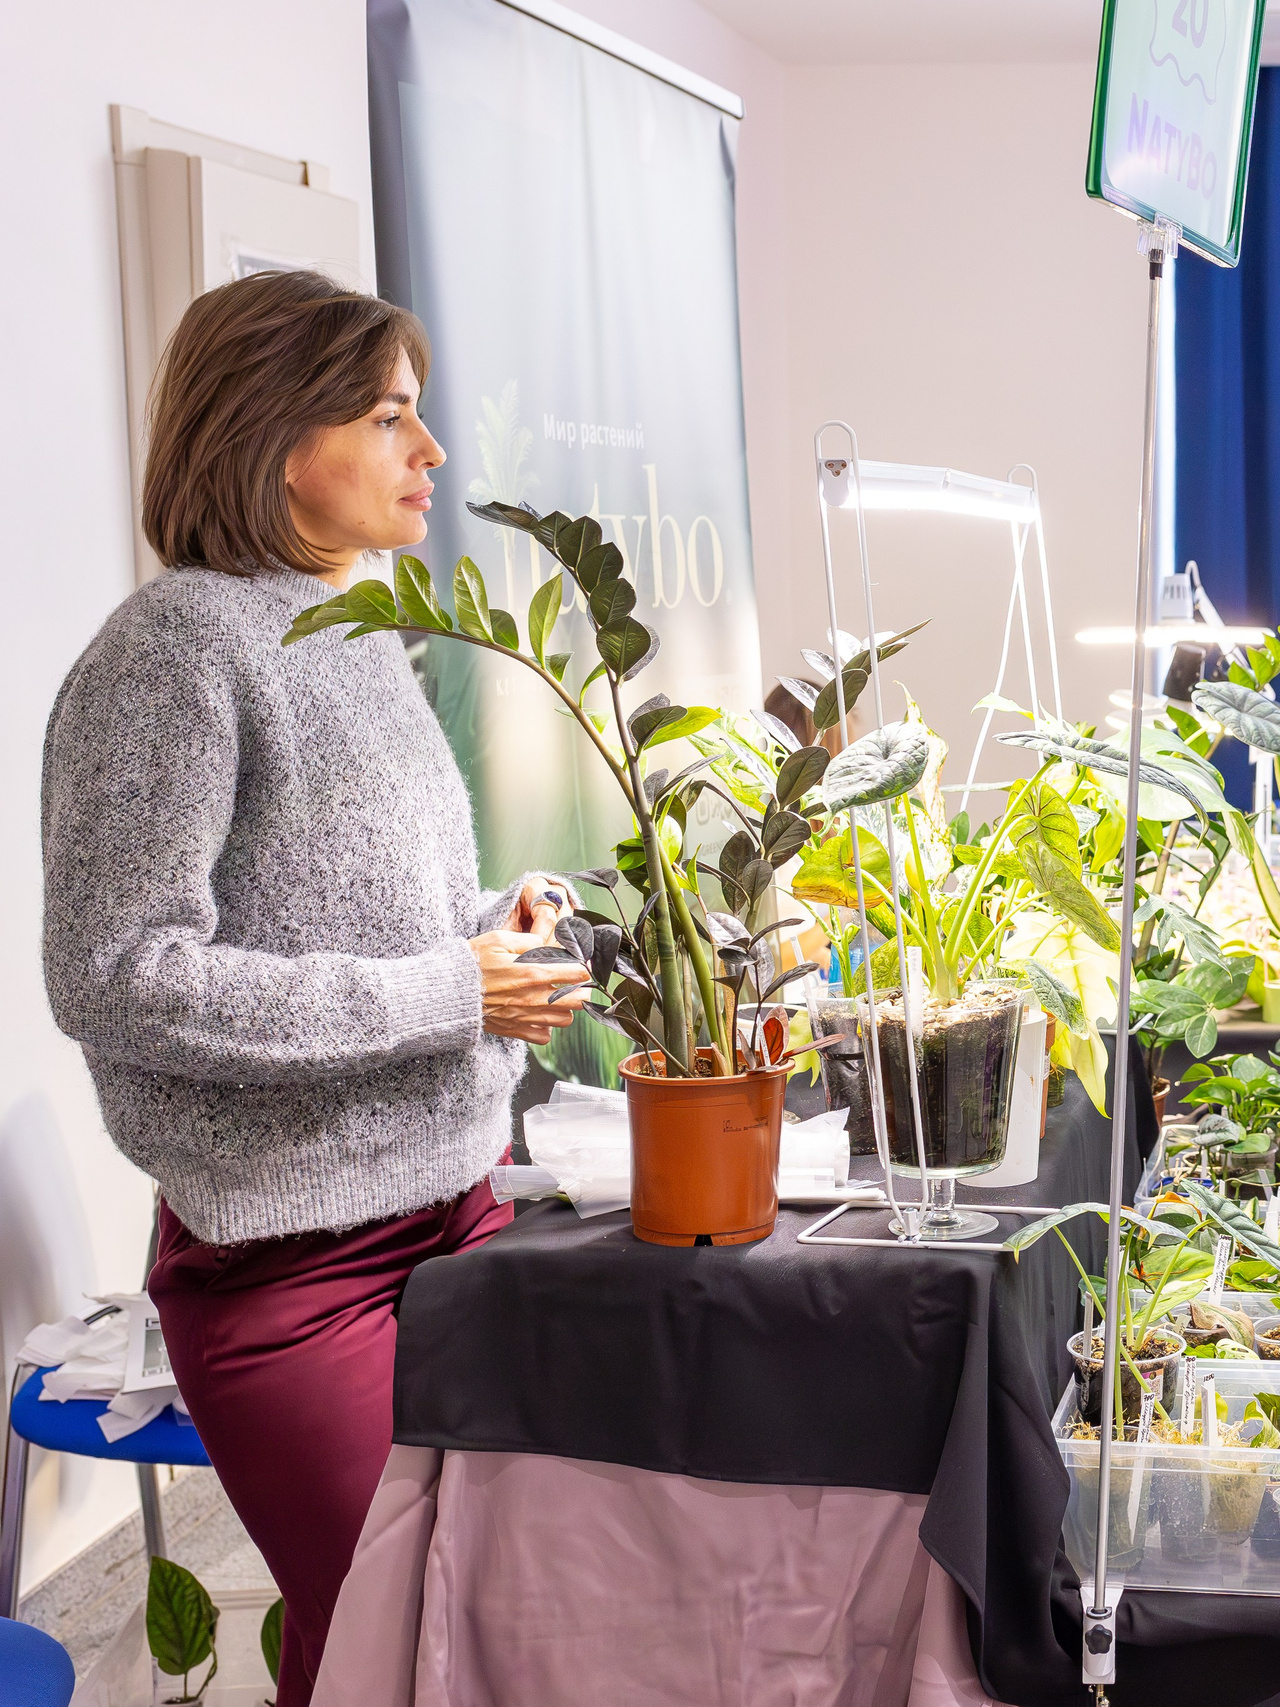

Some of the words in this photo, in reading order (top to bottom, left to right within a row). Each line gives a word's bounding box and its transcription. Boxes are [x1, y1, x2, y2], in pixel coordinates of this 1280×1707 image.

[1127, 92, 1218, 200] NATYBO
[543, 412, 577, 449] Мир
[580, 421, 644, 450] растений
